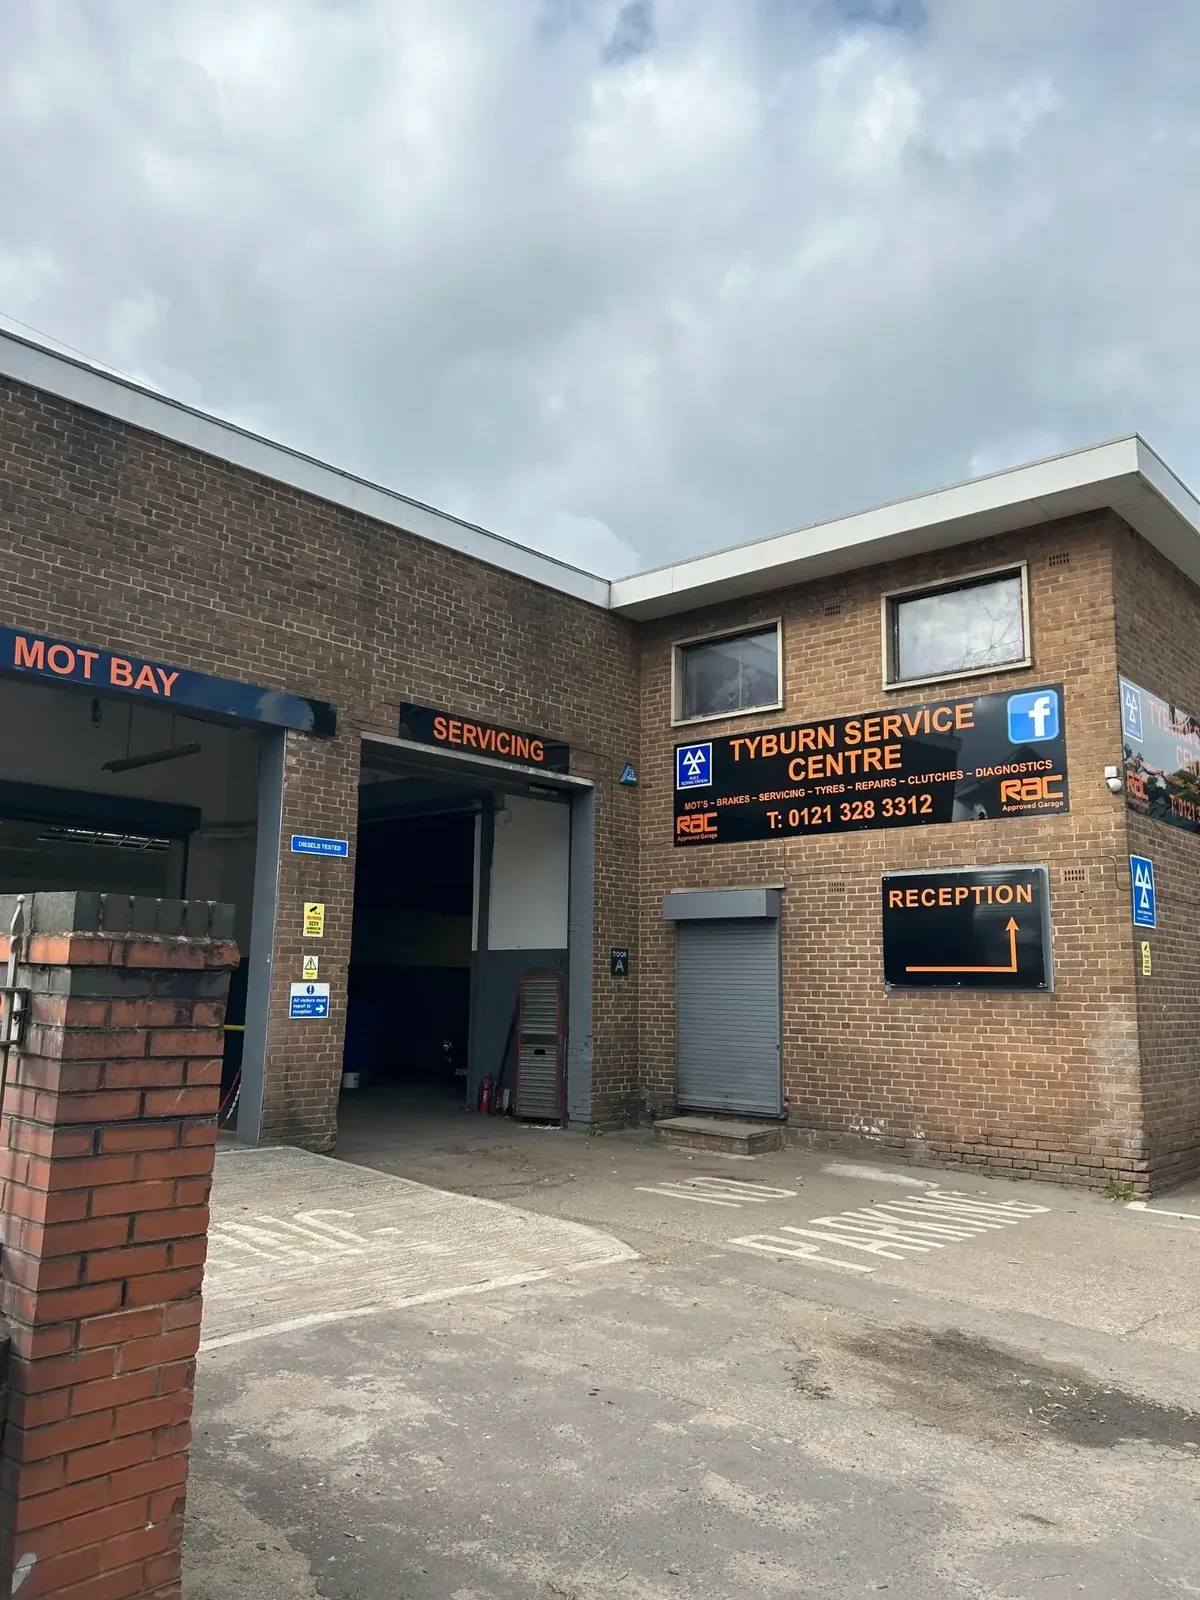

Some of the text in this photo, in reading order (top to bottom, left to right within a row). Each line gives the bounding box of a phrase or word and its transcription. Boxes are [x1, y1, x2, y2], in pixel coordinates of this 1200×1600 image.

[14, 636, 180, 696] MOT BAY
[433, 717, 544, 761] SERVICING
[730, 703, 974, 761] TYBURN SERVICE
[788, 744, 903, 781] CENTRE
[684, 799, 709, 811] MOT'S
[716, 795, 750, 806] BRAKES
[758, 788, 805, 801] SERVICING
[815, 784, 845, 795] TYRES
[855, 778, 897, 791] REPAIRS
[907, 770, 964, 785] CLUTCHES
[975, 759, 1053, 777] DIAGNOSTICS
[766, 794, 933, 829] T: 0121 328 3312
[1002, 800, 1064, 813] Approved Garage
[298, 841, 342, 851] DIESELS TESTED
[677, 834, 700, 843] Approved
[889, 883, 1032, 908] RECEPTION
[612, 950, 627, 958] DOOR
[614, 959, 625, 973] A
[633, 1176, 798, 1208] NO
[727, 1190, 1053, 1273] PARKING
